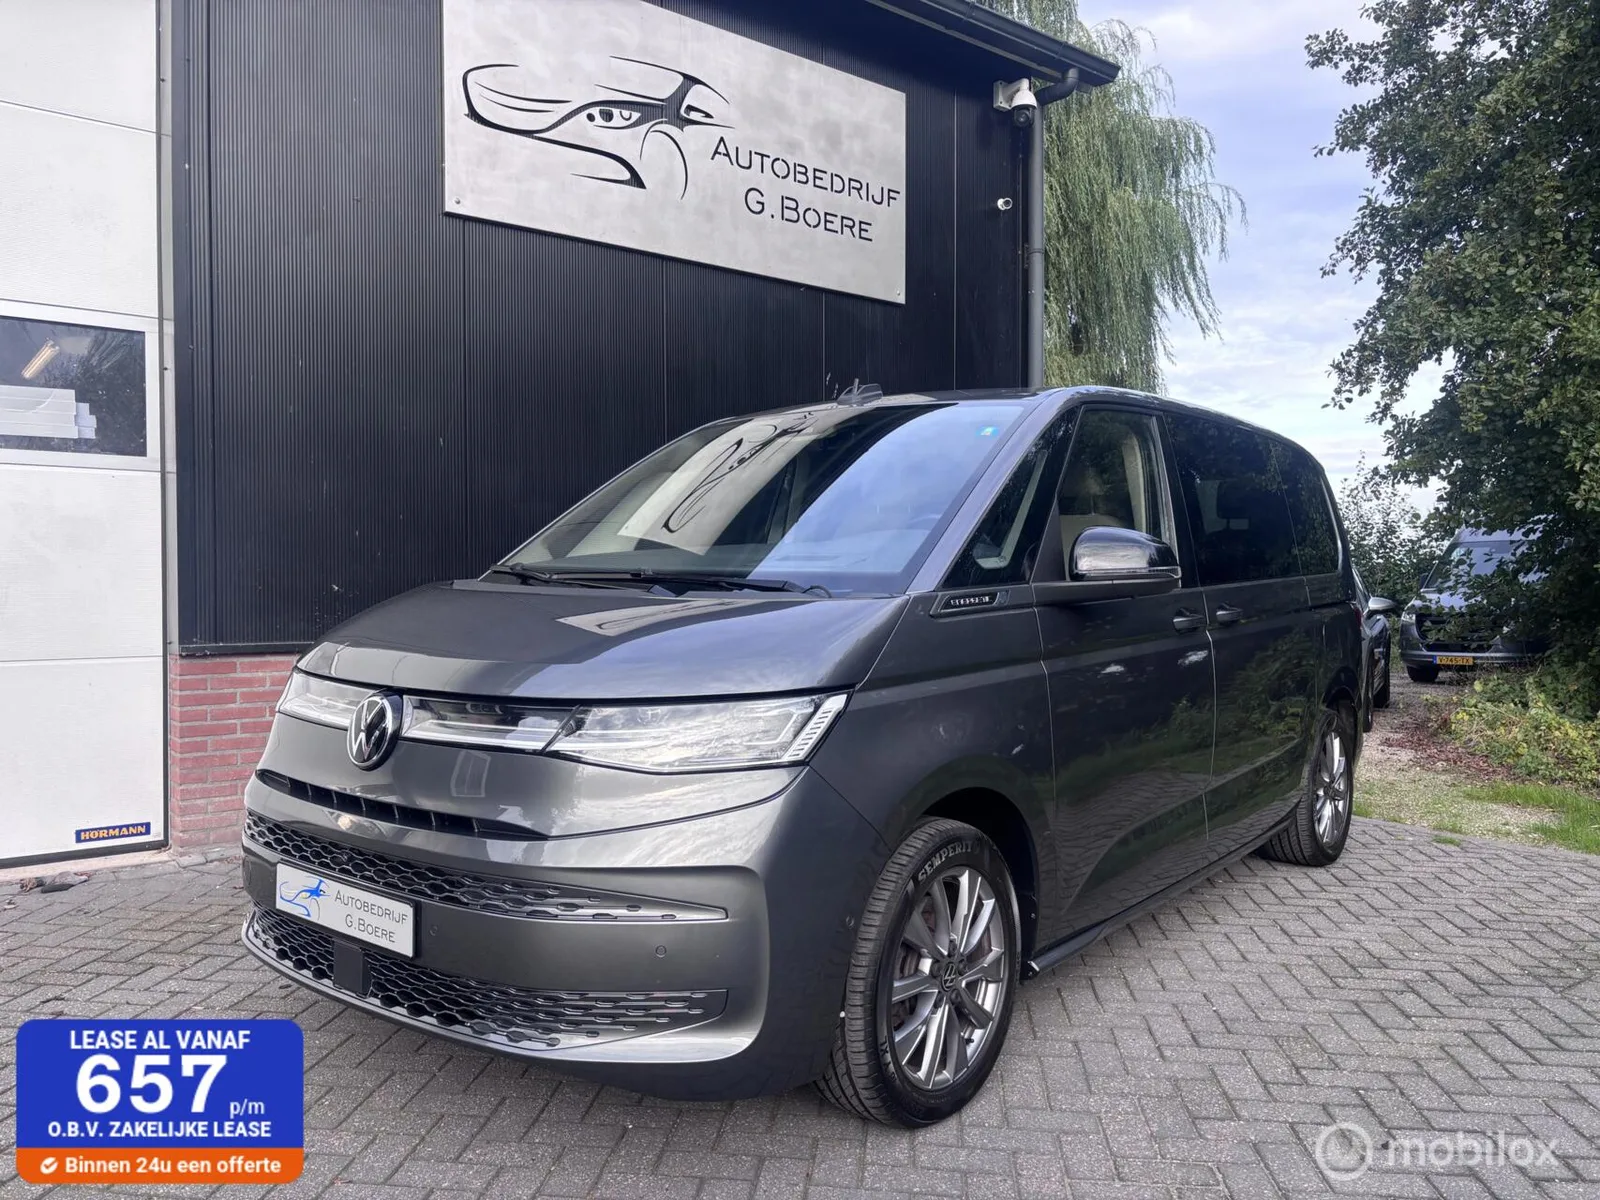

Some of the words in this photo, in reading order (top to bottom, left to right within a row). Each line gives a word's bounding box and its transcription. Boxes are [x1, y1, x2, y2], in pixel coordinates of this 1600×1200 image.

[710, 136, 900, 207] AUTOBEDRIJF
[918, 841, 973, 880] SEMPERIT
[334, 890, 408, 925] AUTOBEDRIJF
